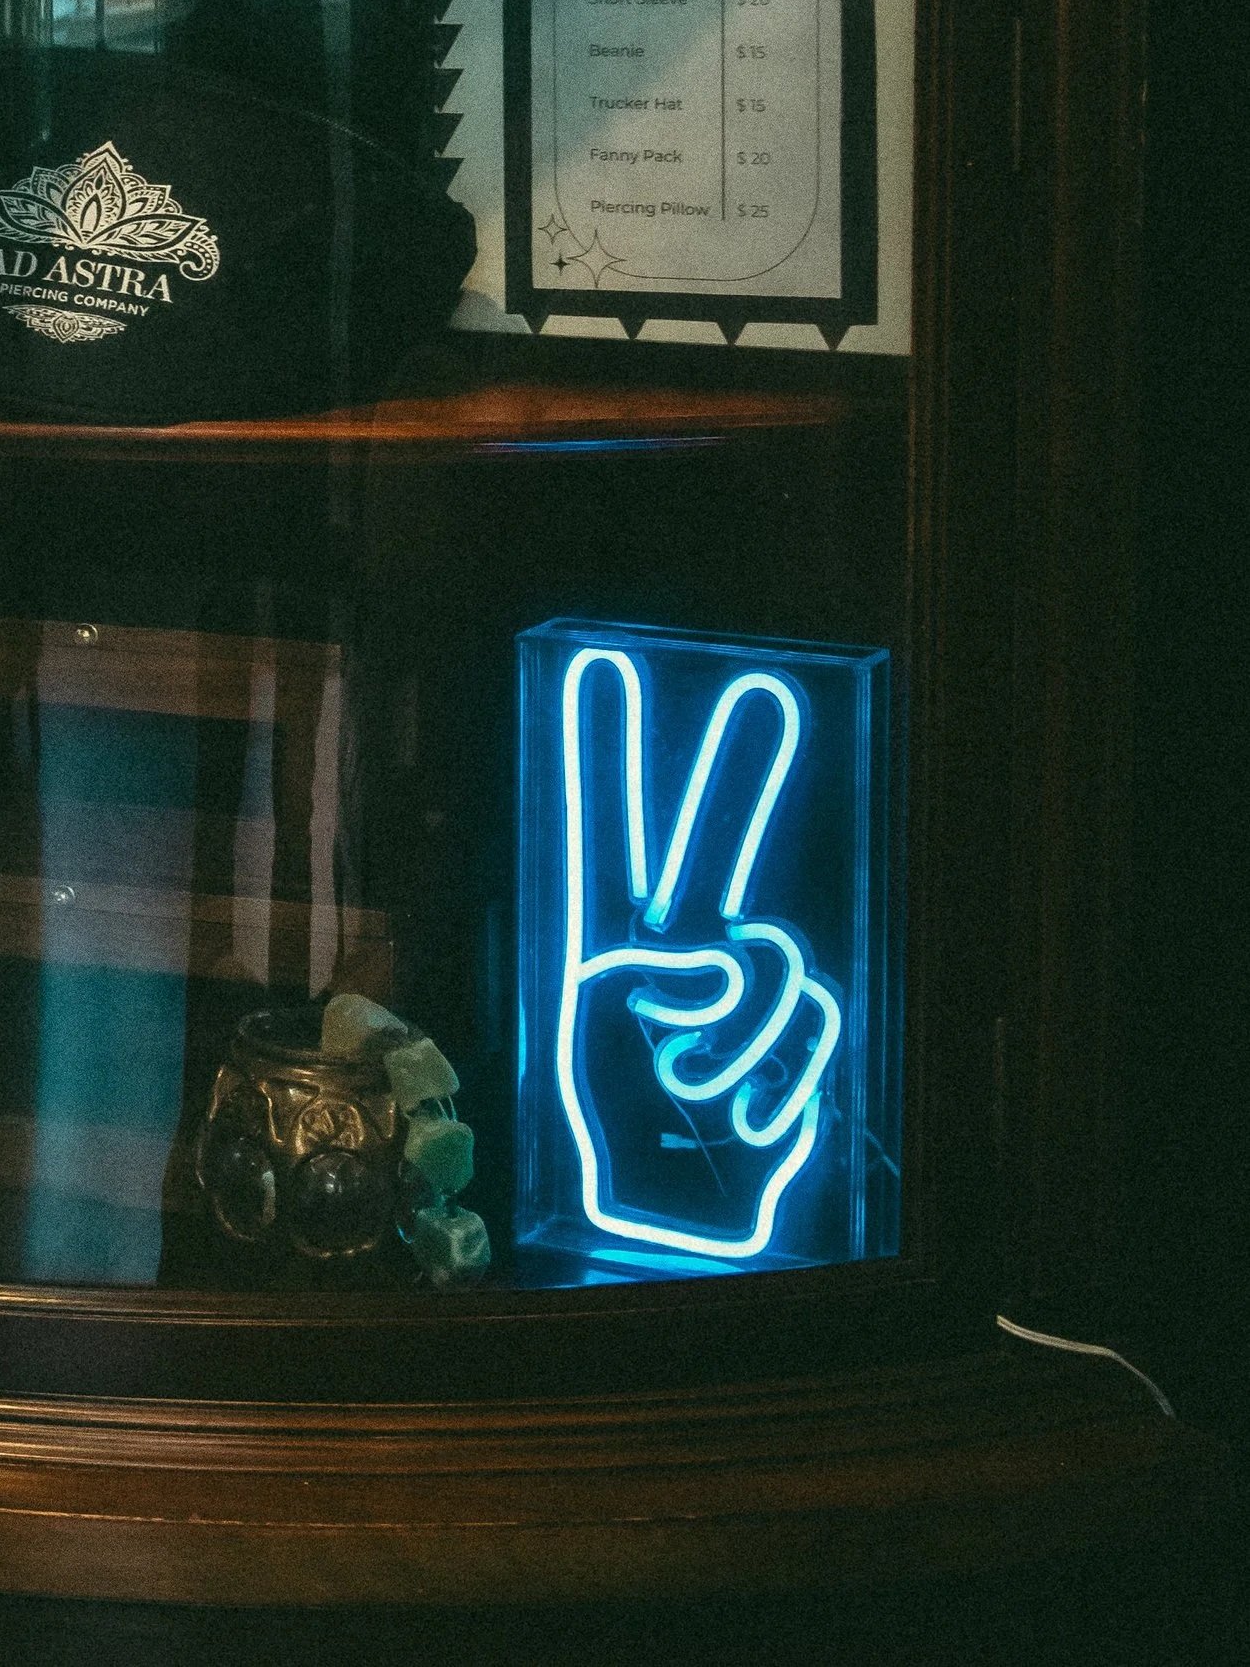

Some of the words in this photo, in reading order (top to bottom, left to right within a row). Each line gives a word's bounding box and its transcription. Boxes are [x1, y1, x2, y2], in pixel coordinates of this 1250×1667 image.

[588, 44, 645, 57] Beanie
[736, 45, 746, 59] $
[749, 45, 766, 59] 15
[589, 96, 649, 110] Trucker
[655, 98, 683, 110] Hat
[736, 98, 746, 112] $
[750, 99, 766, 112] 15
[590, 148, 638, 165] Fanny
[643, 149, 683, 163] Pack
[736, 151, 747, 165] $
[750, 152, 771, 165] 20
[590, 200, 656, 218] Piercing
[660, 201, 711, 216] Pillow
[737, 204, 746, 218] $
[751, 205, 770, 218] 25
[42, 255, 174, 304] ASTRA
[0, 283, 69, 302] PIERCING
[73, 294, 150, 317] COMPANY
